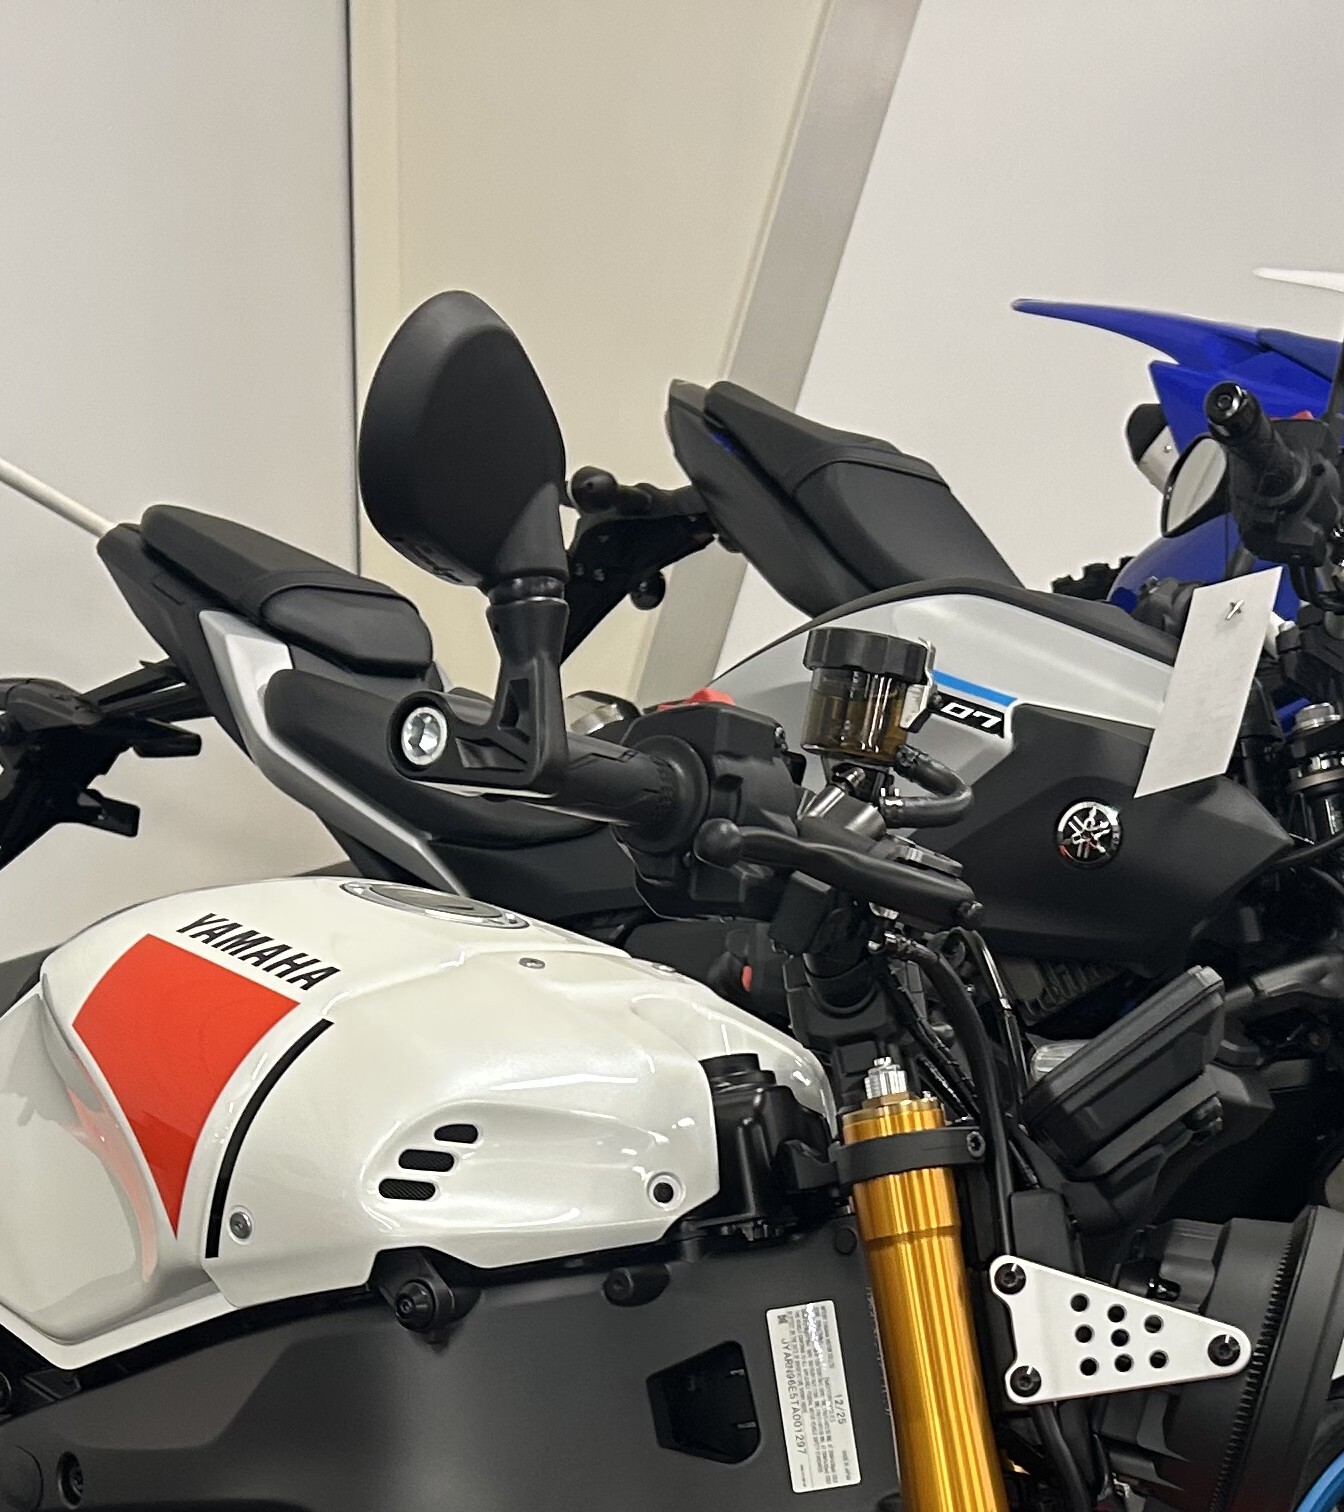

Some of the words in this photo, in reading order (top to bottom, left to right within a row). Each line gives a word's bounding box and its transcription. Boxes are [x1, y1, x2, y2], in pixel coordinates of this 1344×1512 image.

[940, 702, 1002, 728] 07
[176, 913, 341, 990] YAMAHA
[833, 1393, 847, 1425] 12/25
